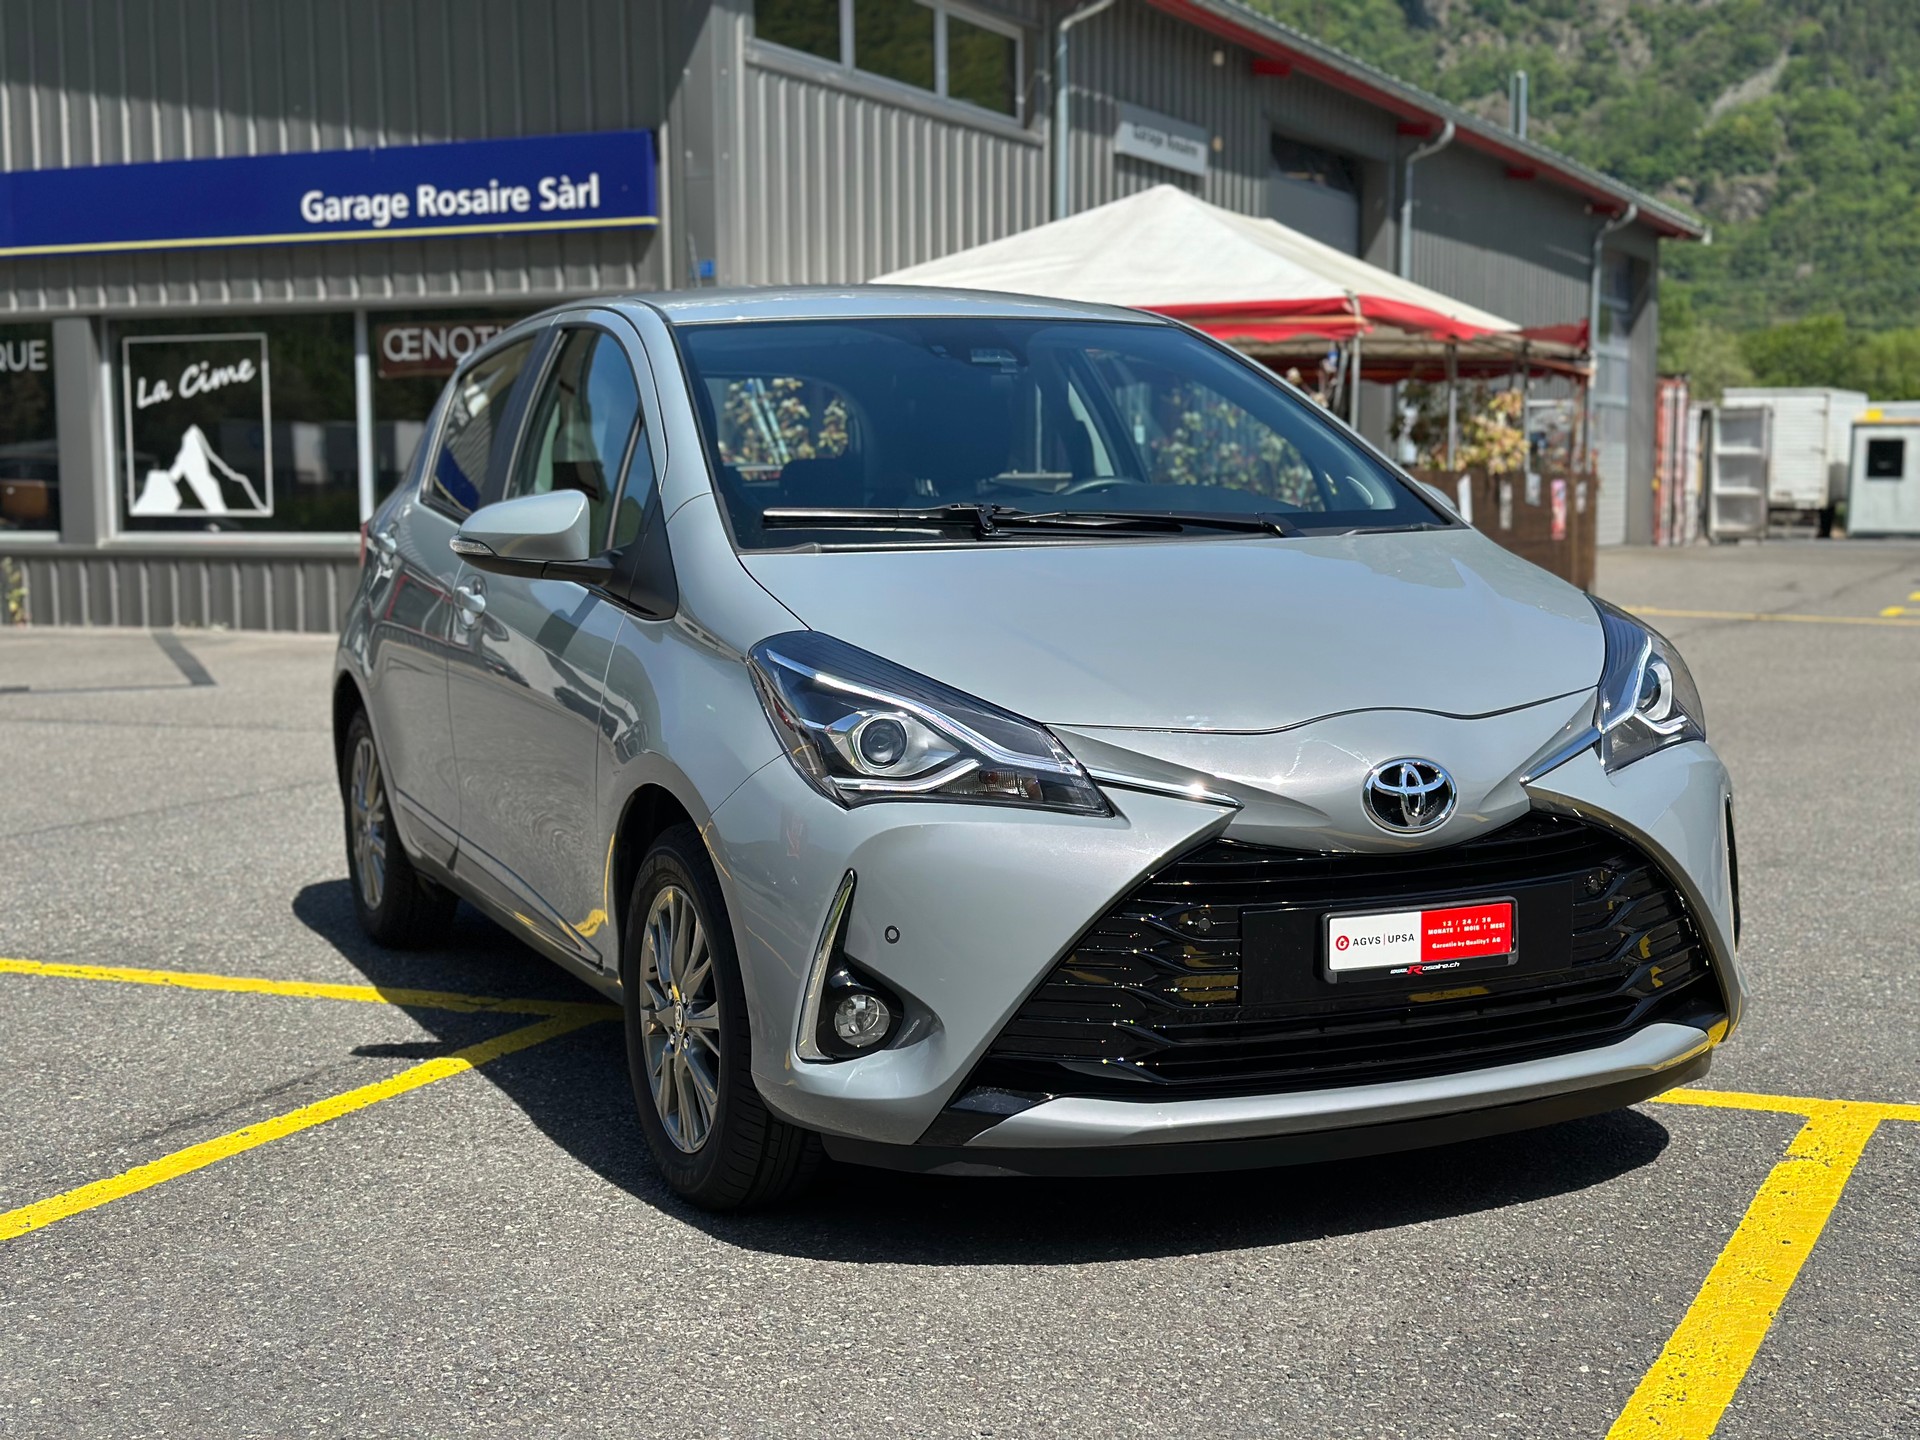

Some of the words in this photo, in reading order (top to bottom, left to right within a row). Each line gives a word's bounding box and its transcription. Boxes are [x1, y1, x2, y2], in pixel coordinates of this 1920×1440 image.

[300, 190, 409, 228] Garage
[416, 178, 530, 217] Rosaire
[538, 172, 600, 211] Sàrl
[136, 376, 173, 410] La
[178, 358, 256, 399] Cime
[1352, 935, 1381, 947] AGVS
[1387, 933, 1415, 944] UPSA
